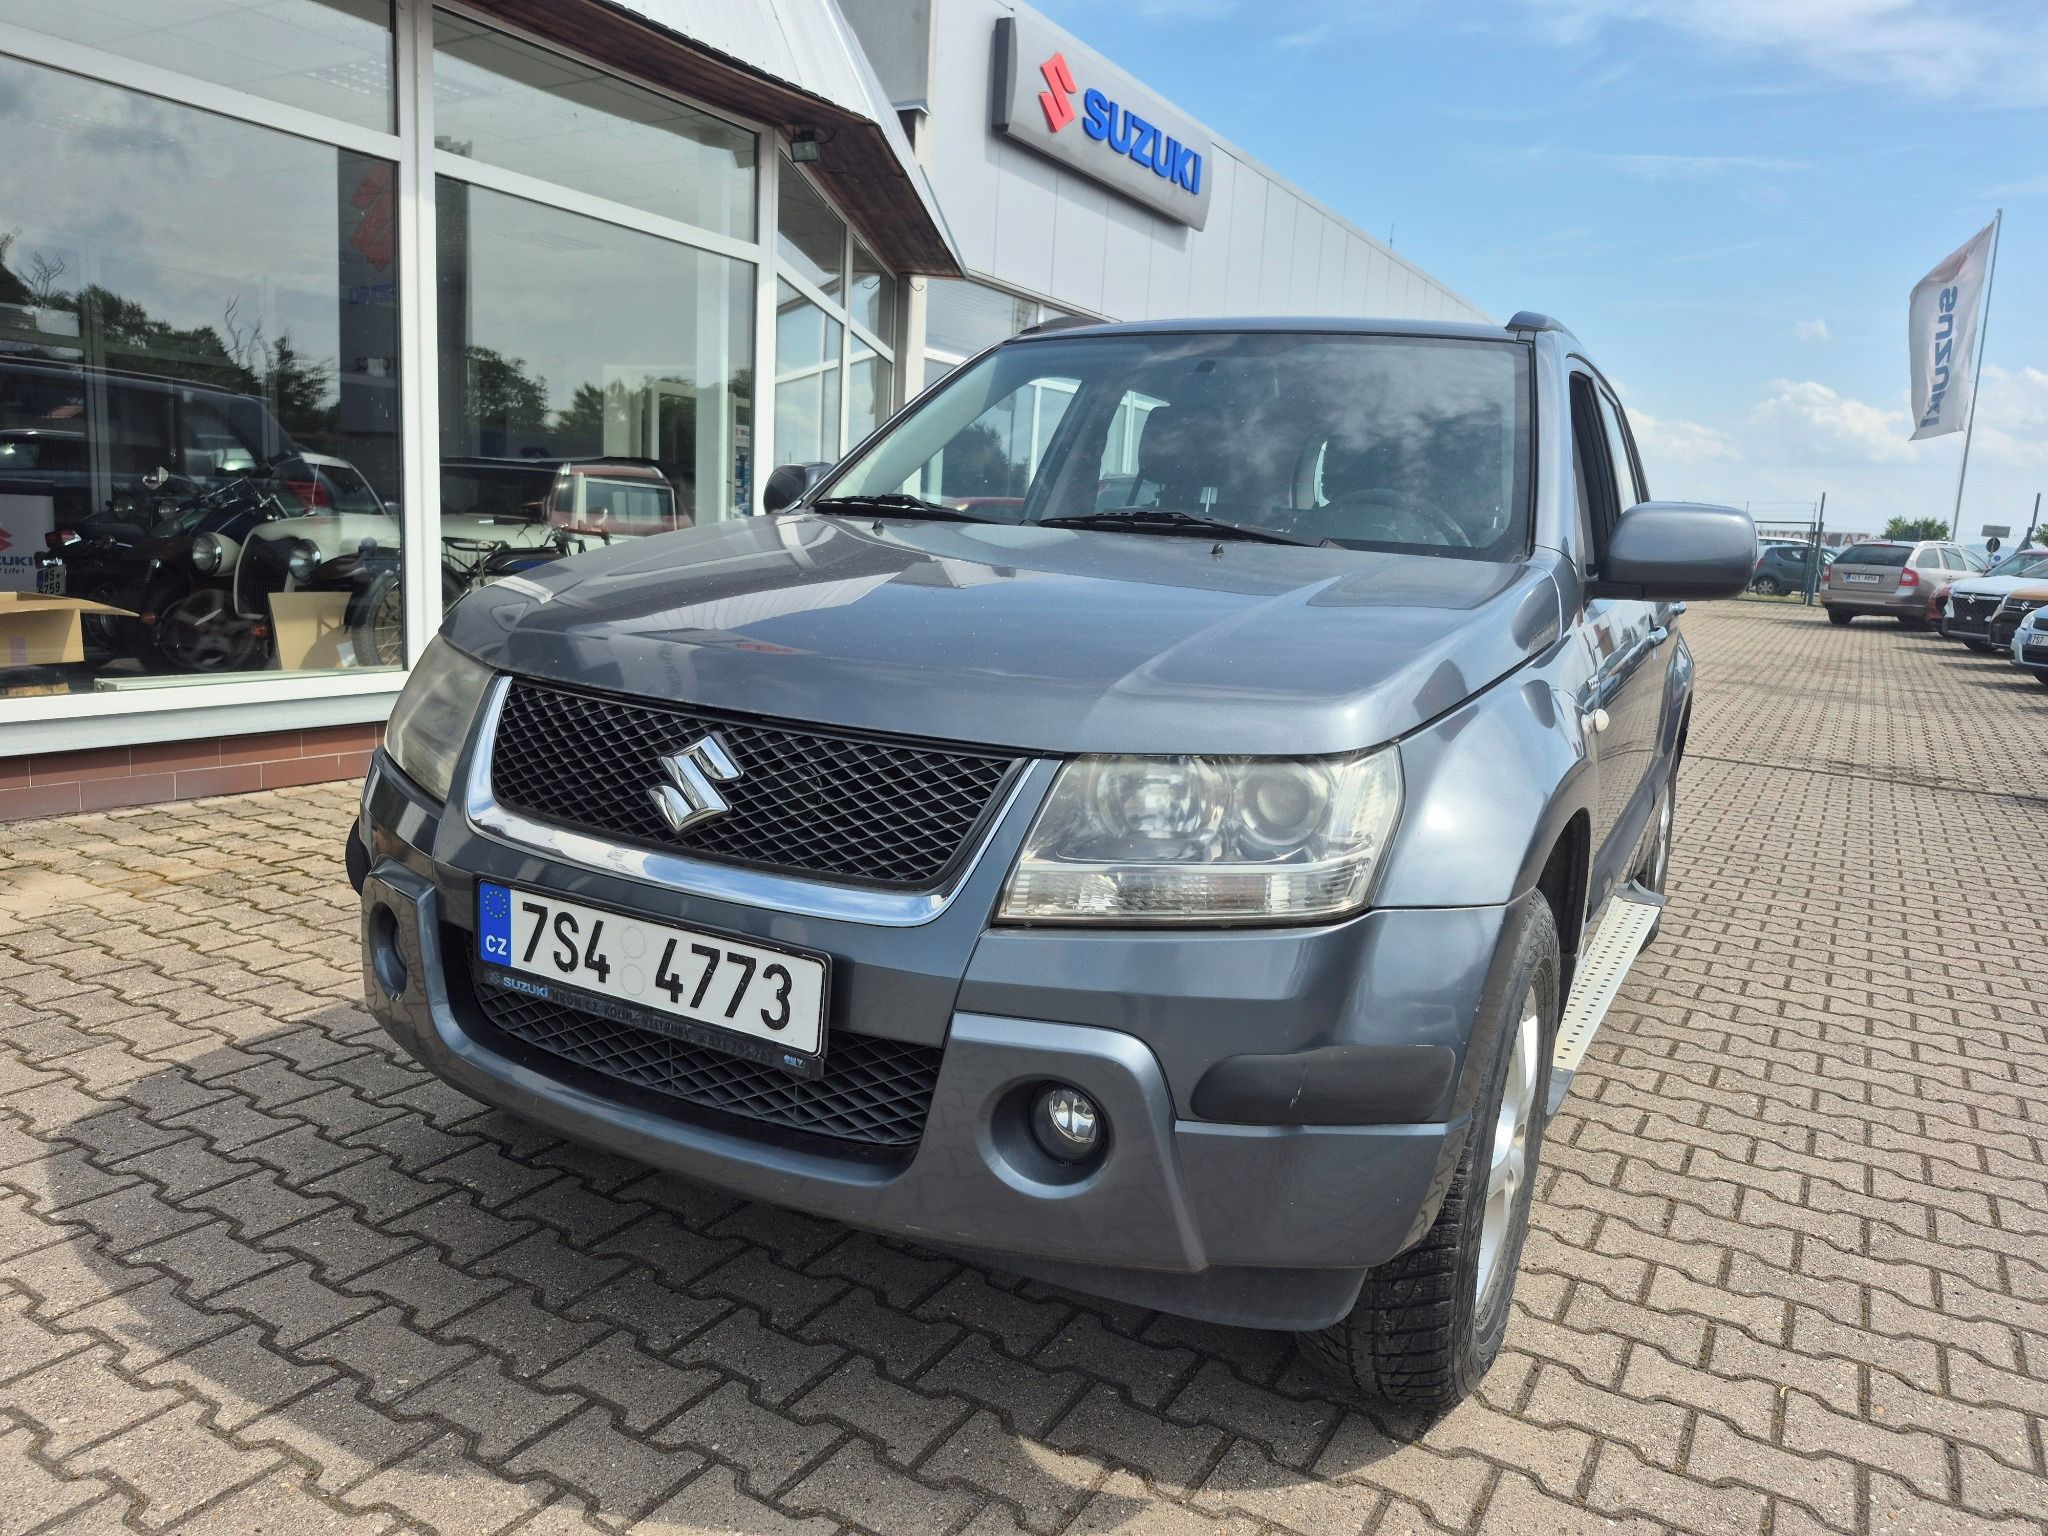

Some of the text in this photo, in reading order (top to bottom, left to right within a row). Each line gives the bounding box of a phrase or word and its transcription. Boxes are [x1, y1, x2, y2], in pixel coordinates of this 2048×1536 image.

[1082, 88, 1202, 195] SUZUKI
[0, 556, 33, 567] UKI
[485, 902, 793, 1031] CZ 7S4 4773
[503, 976, 549, 998] SUZUKI
